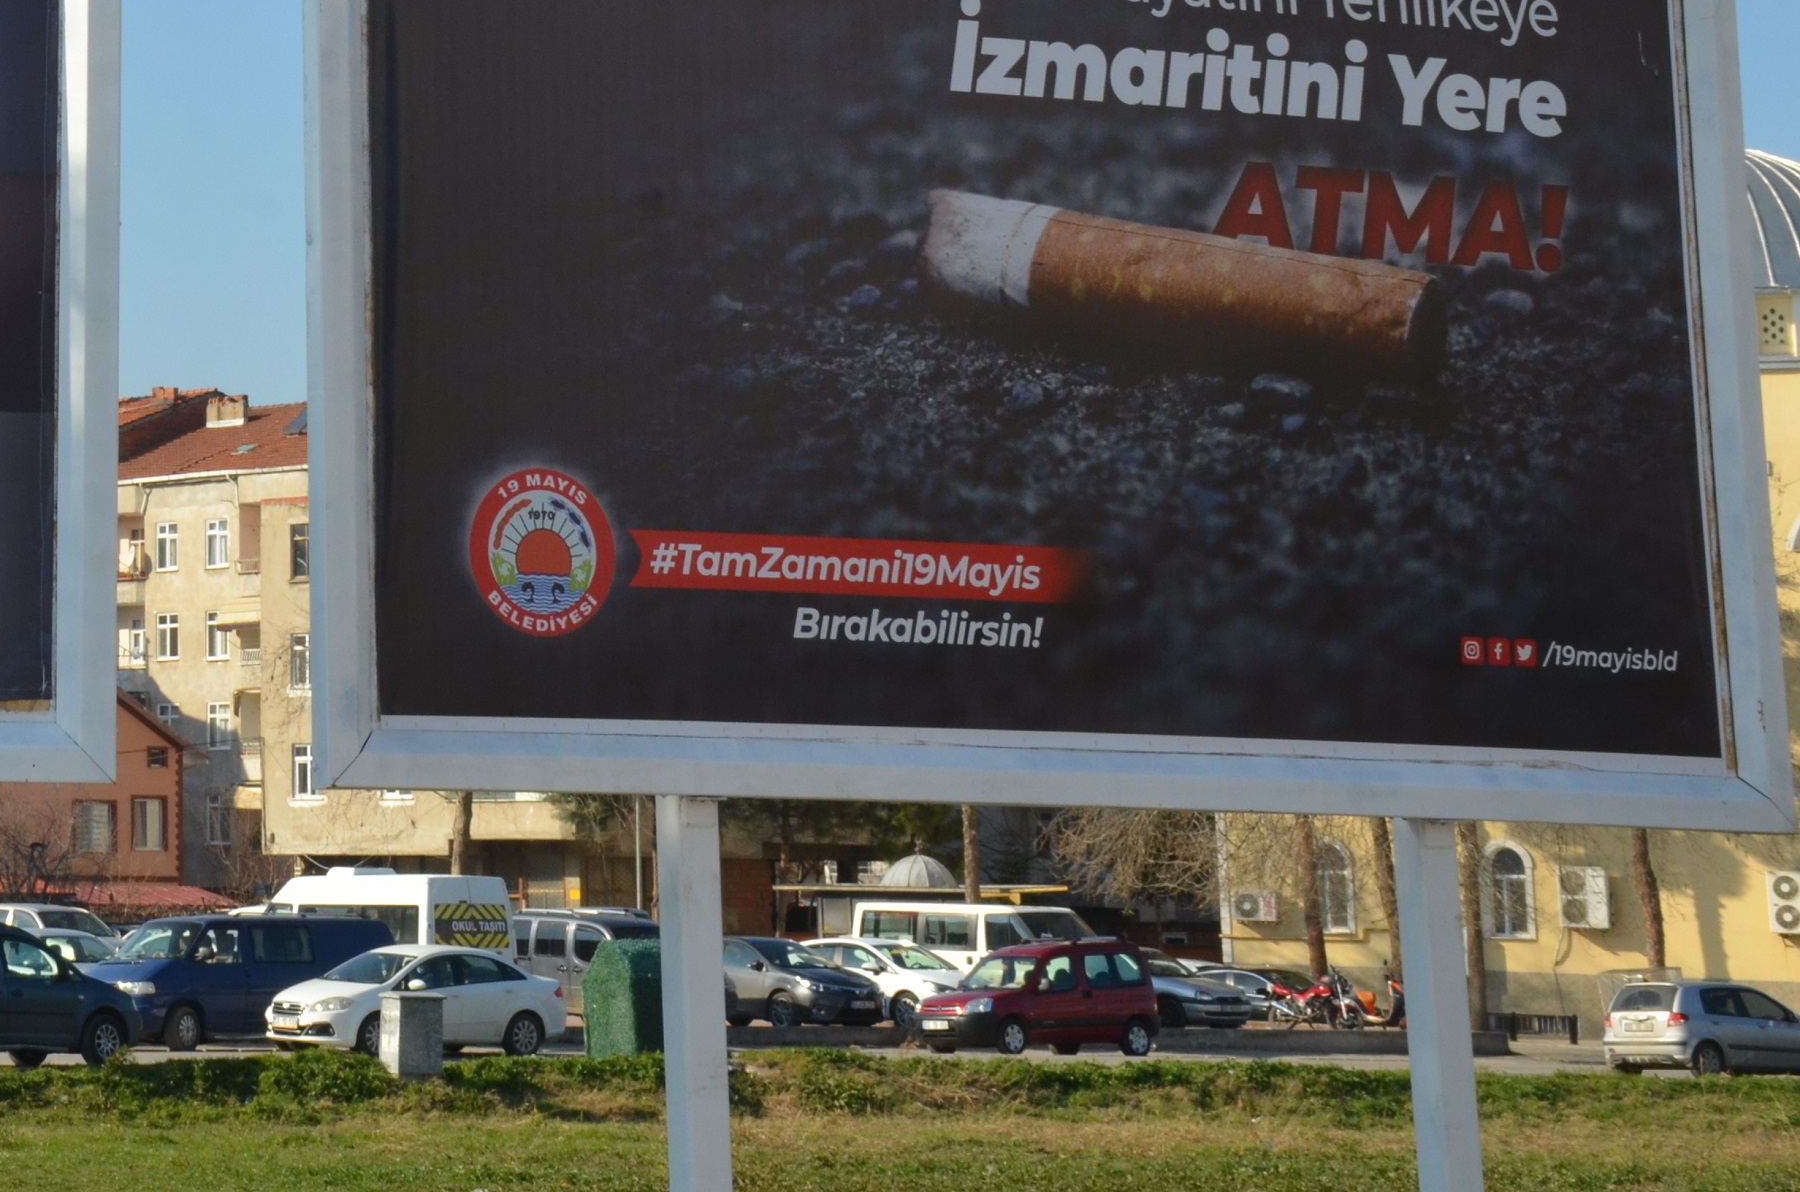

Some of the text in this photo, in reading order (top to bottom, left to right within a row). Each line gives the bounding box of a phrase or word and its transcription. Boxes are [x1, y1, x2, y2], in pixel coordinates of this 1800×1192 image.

[1387, 53, 1568, 138] Yere
[1211, 161, 1570, 274] ATMA!
[497, 473, 588, 506] 19 MAYIS
[528, 510, 556, 521] 1970
[649, 542, 1042, 597] #TamZamani19Mayis
[487, 589, 598, 633] BELEDİYESİ
[792, 606, 1045, 649] Bırakabilirsin!
[1542, 640, 1679, 674] /19mayisbld
[451, 920, 506, 934] OKUL TAŞITI
